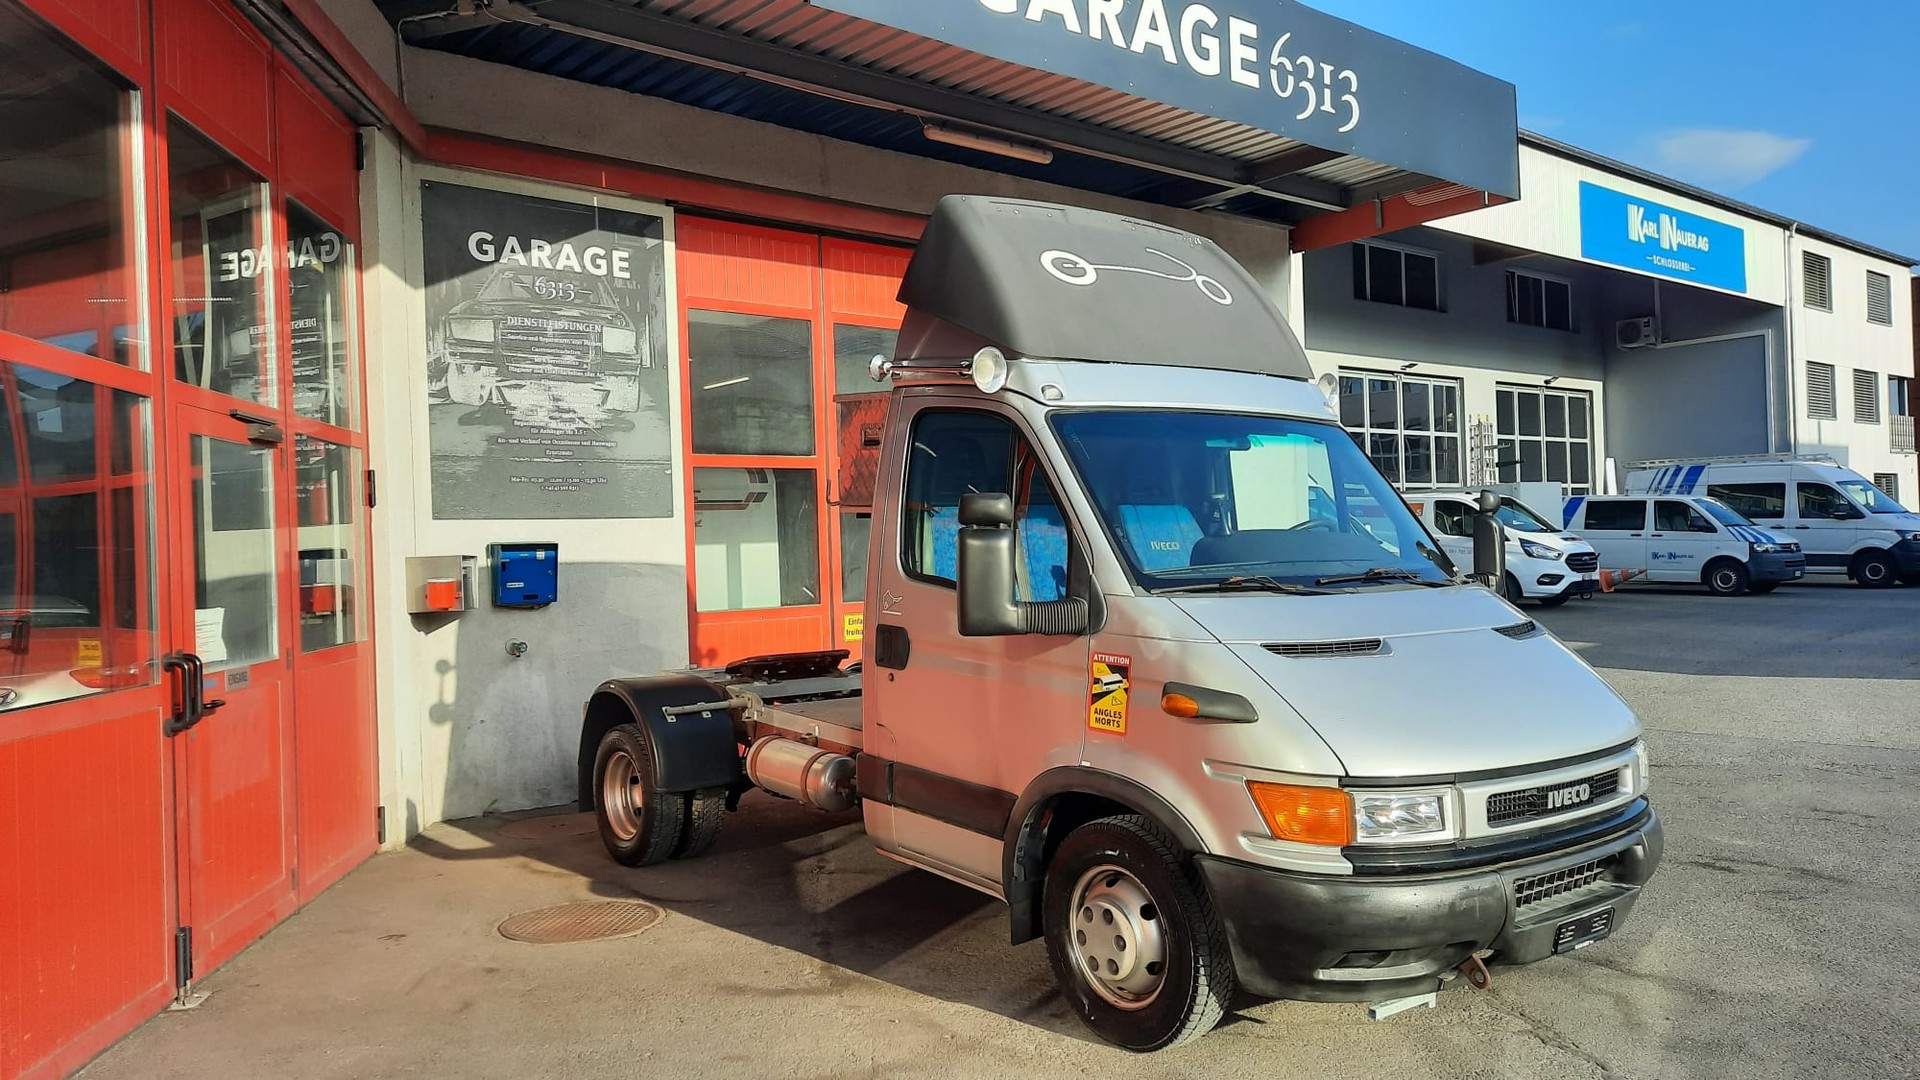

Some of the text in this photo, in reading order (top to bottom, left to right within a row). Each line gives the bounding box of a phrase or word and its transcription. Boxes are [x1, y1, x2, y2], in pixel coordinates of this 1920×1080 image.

[977, 0, 1361, 134] ARAGE 6313
[1697, 234, 1709, 252] AG
[467, 231, 631, 279] GARAGE
[535, 276, 575, 301] 6313
[507, 316, 602, 333] DIENSTLEISTUNGEN
[1150, 540, 1180, 551] IVECO
[1093, 653, 1130, 665] ATTENTION
[1094, 707, 1122, 720] ANGLES
[1094, 717, 1121, 728] MORTS
[1547, 783, 1590, 809] IVECO
